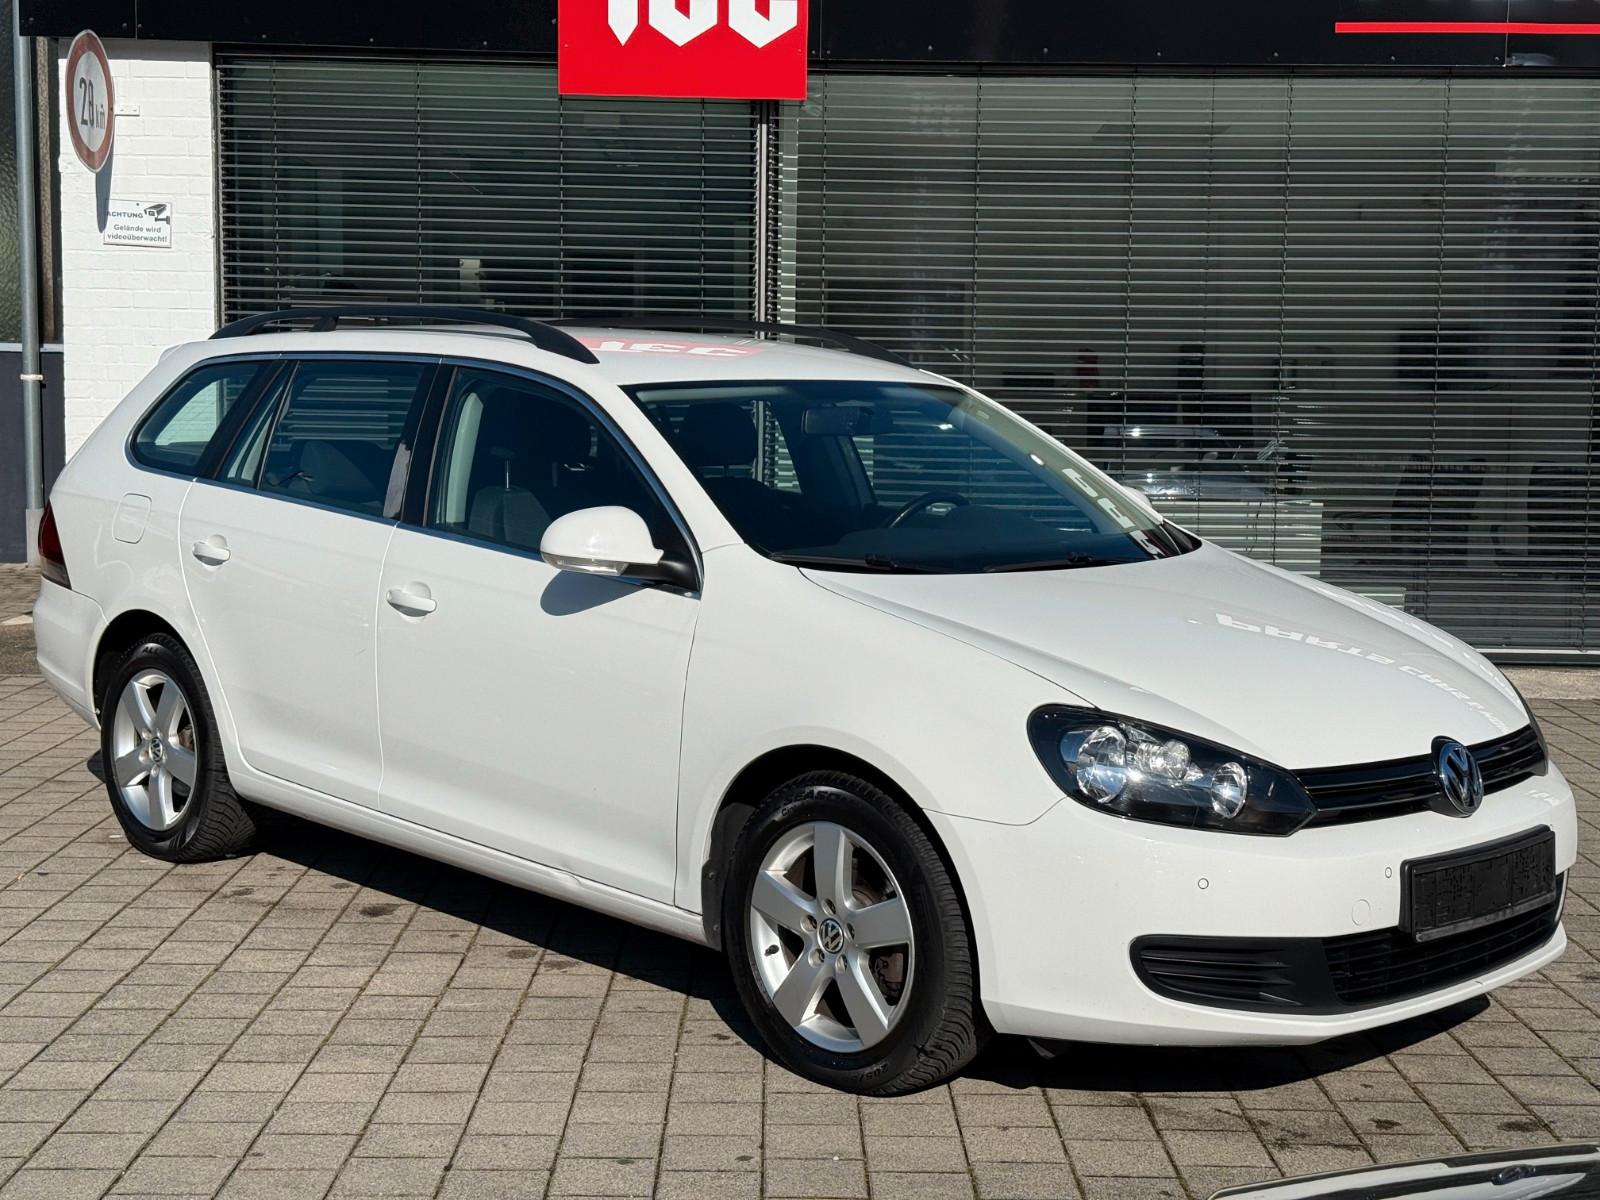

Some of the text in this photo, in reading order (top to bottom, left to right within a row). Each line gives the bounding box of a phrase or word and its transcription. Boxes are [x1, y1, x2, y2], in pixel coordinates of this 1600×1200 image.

[107, 211, 144, 219] ACHTUNG
[113, 224, 144, 232] Gelände
[107, 233, 168, 243] videoüberwacht!
